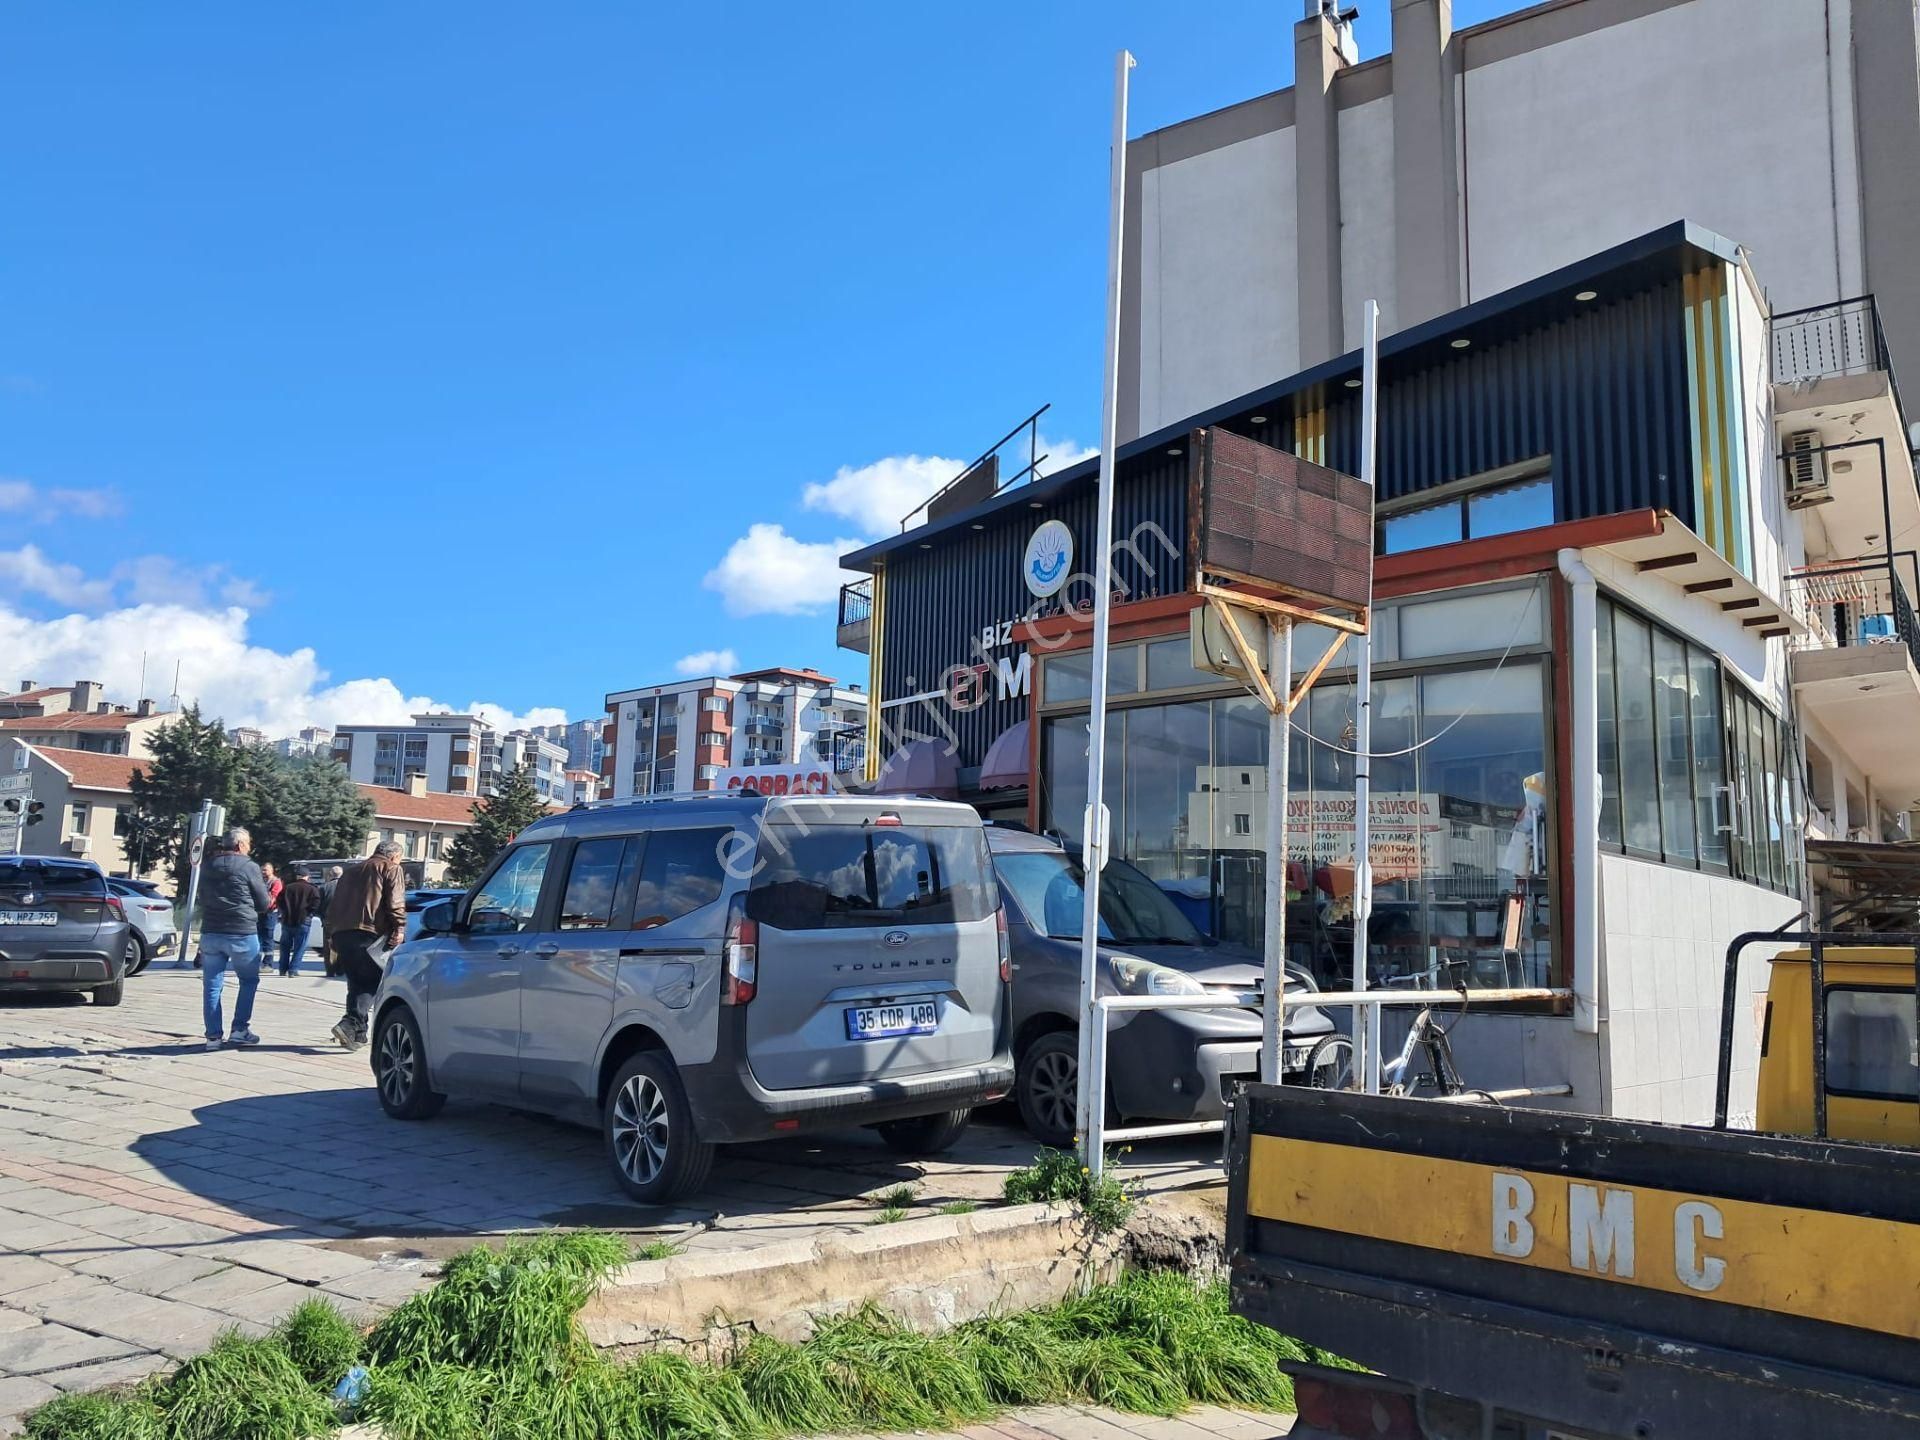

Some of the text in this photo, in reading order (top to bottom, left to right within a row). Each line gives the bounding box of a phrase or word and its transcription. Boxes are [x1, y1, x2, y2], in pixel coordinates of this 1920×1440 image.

[982, 612, 1039, 650] BİZ
[951, 663, 990, 710] ET
[833, 957, 952, 972] TOURNEO
[857, 1010, 875, 1030] 35
[880, 1008, 905, 1028] CDR
[1492, 1171, 1725, 1292] BMC
